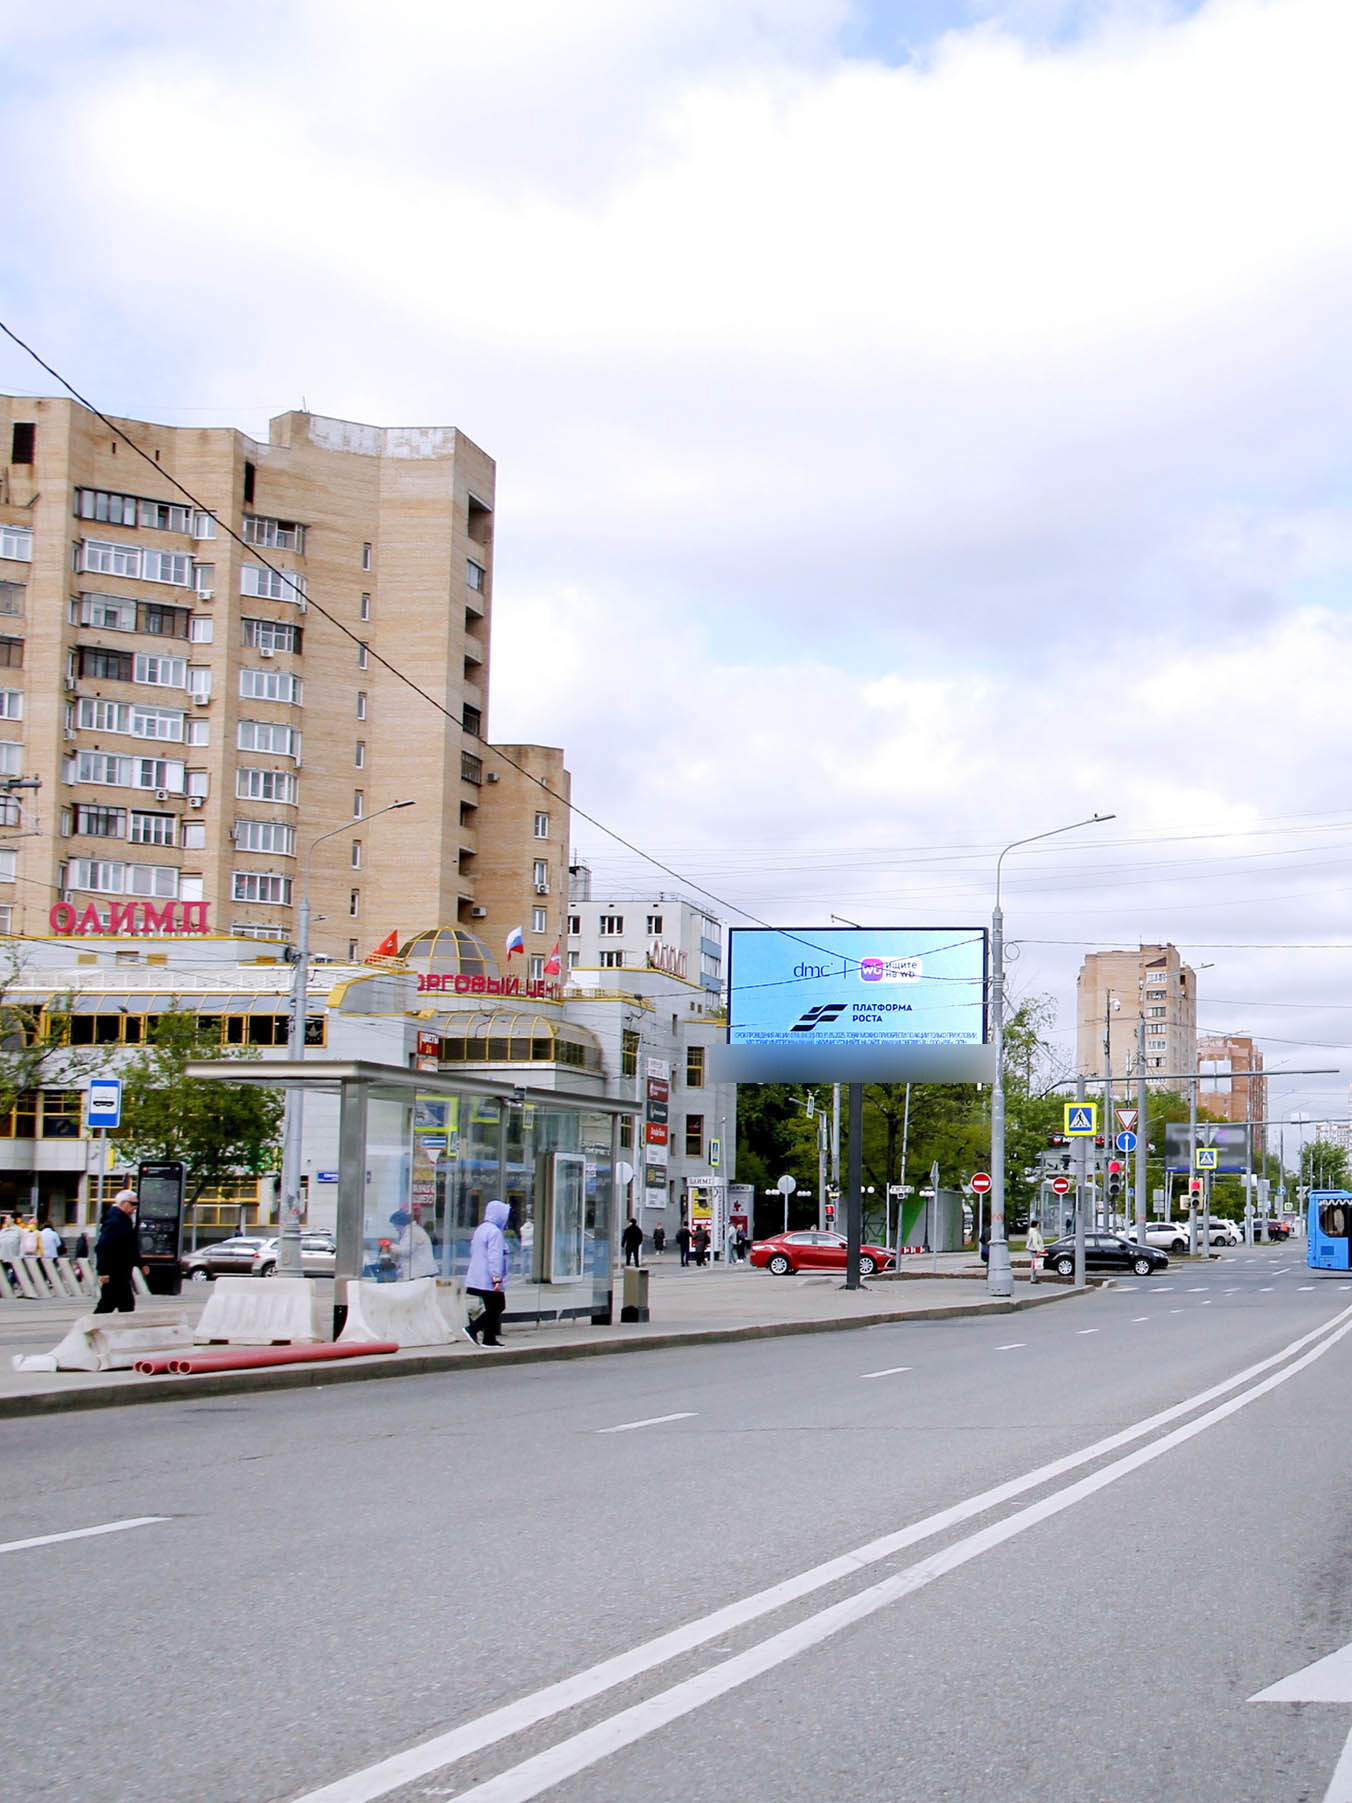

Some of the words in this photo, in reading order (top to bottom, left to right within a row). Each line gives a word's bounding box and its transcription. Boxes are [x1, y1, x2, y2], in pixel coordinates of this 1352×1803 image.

[49, 901, 211, 933] ОЛИМП
[852, 1003, 913, 1012] ПЛАТФОРМА
[852, 1014, 883, 1023] РОСТА
